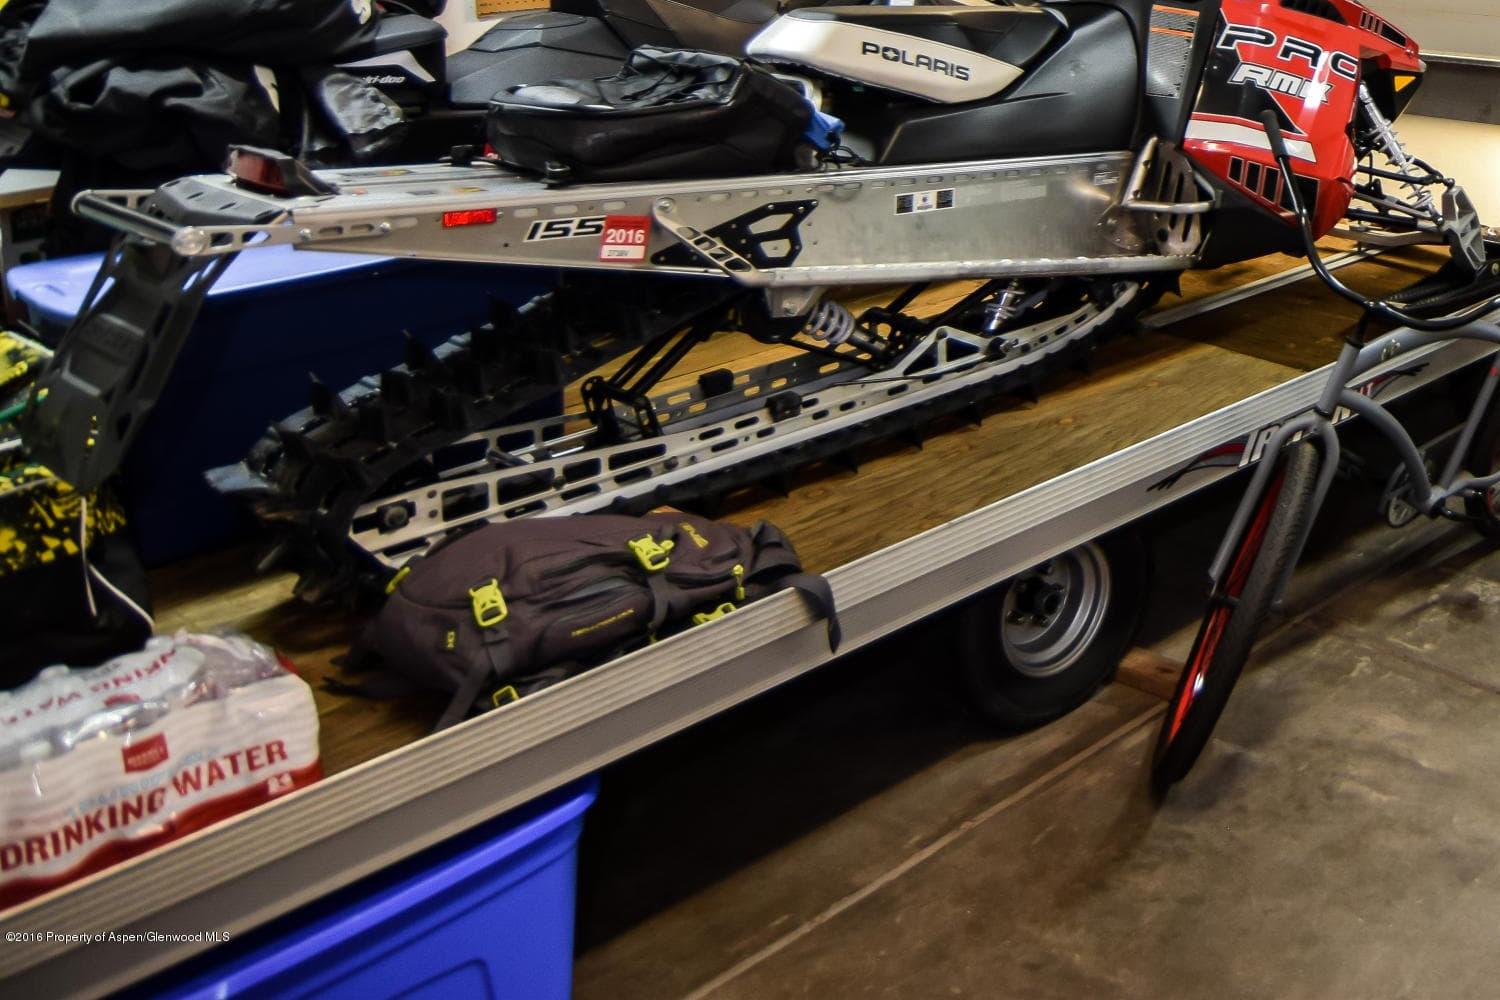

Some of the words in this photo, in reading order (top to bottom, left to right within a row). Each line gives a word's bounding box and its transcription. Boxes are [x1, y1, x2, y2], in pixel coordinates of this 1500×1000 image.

[862, 41, 970, 81] POLARIS
[1227, 61, 1335, 104] RMK
[523, 215, 607, 243] 155
[605, 228, 645, 244] 2016
[0, 787, 168, 872] DRINKING
[172, 739, 289, 797] WATER
